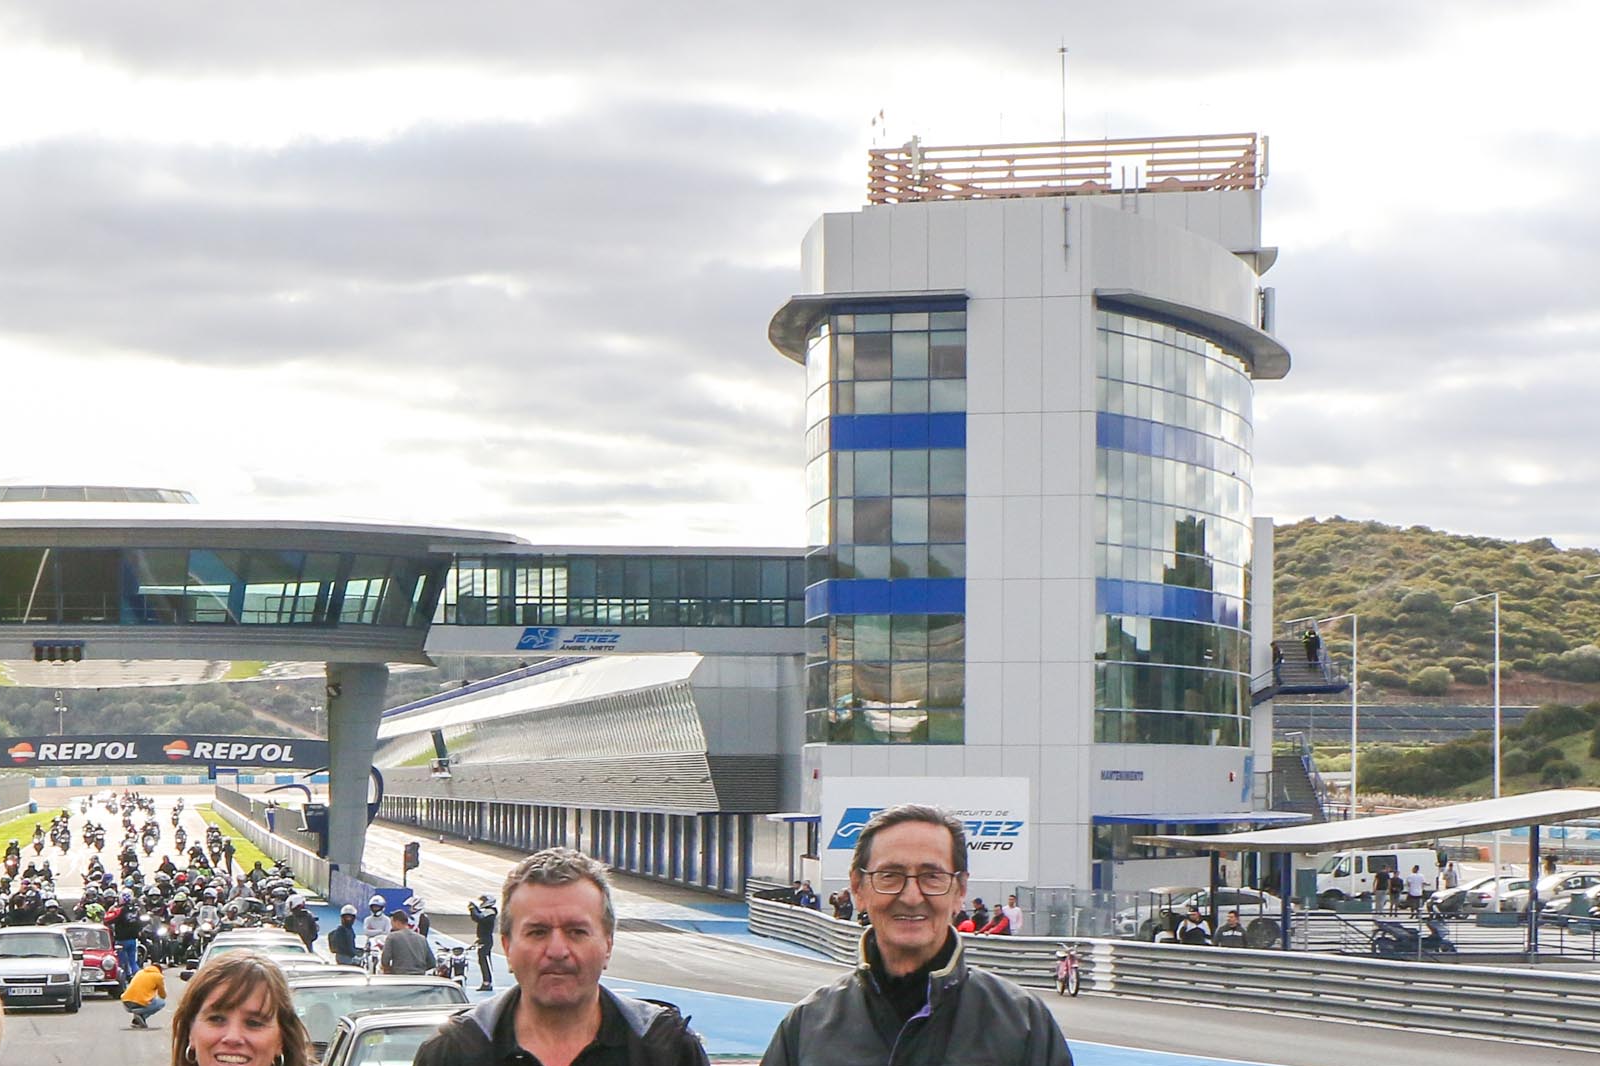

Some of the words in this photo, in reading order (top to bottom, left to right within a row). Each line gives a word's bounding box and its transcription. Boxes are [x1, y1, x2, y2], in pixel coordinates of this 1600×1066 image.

[563, 634, 621, 643] JEREZ
[38, 742, 138, 761] REPSOL
[193, 742, 294, 762] REPSOL
